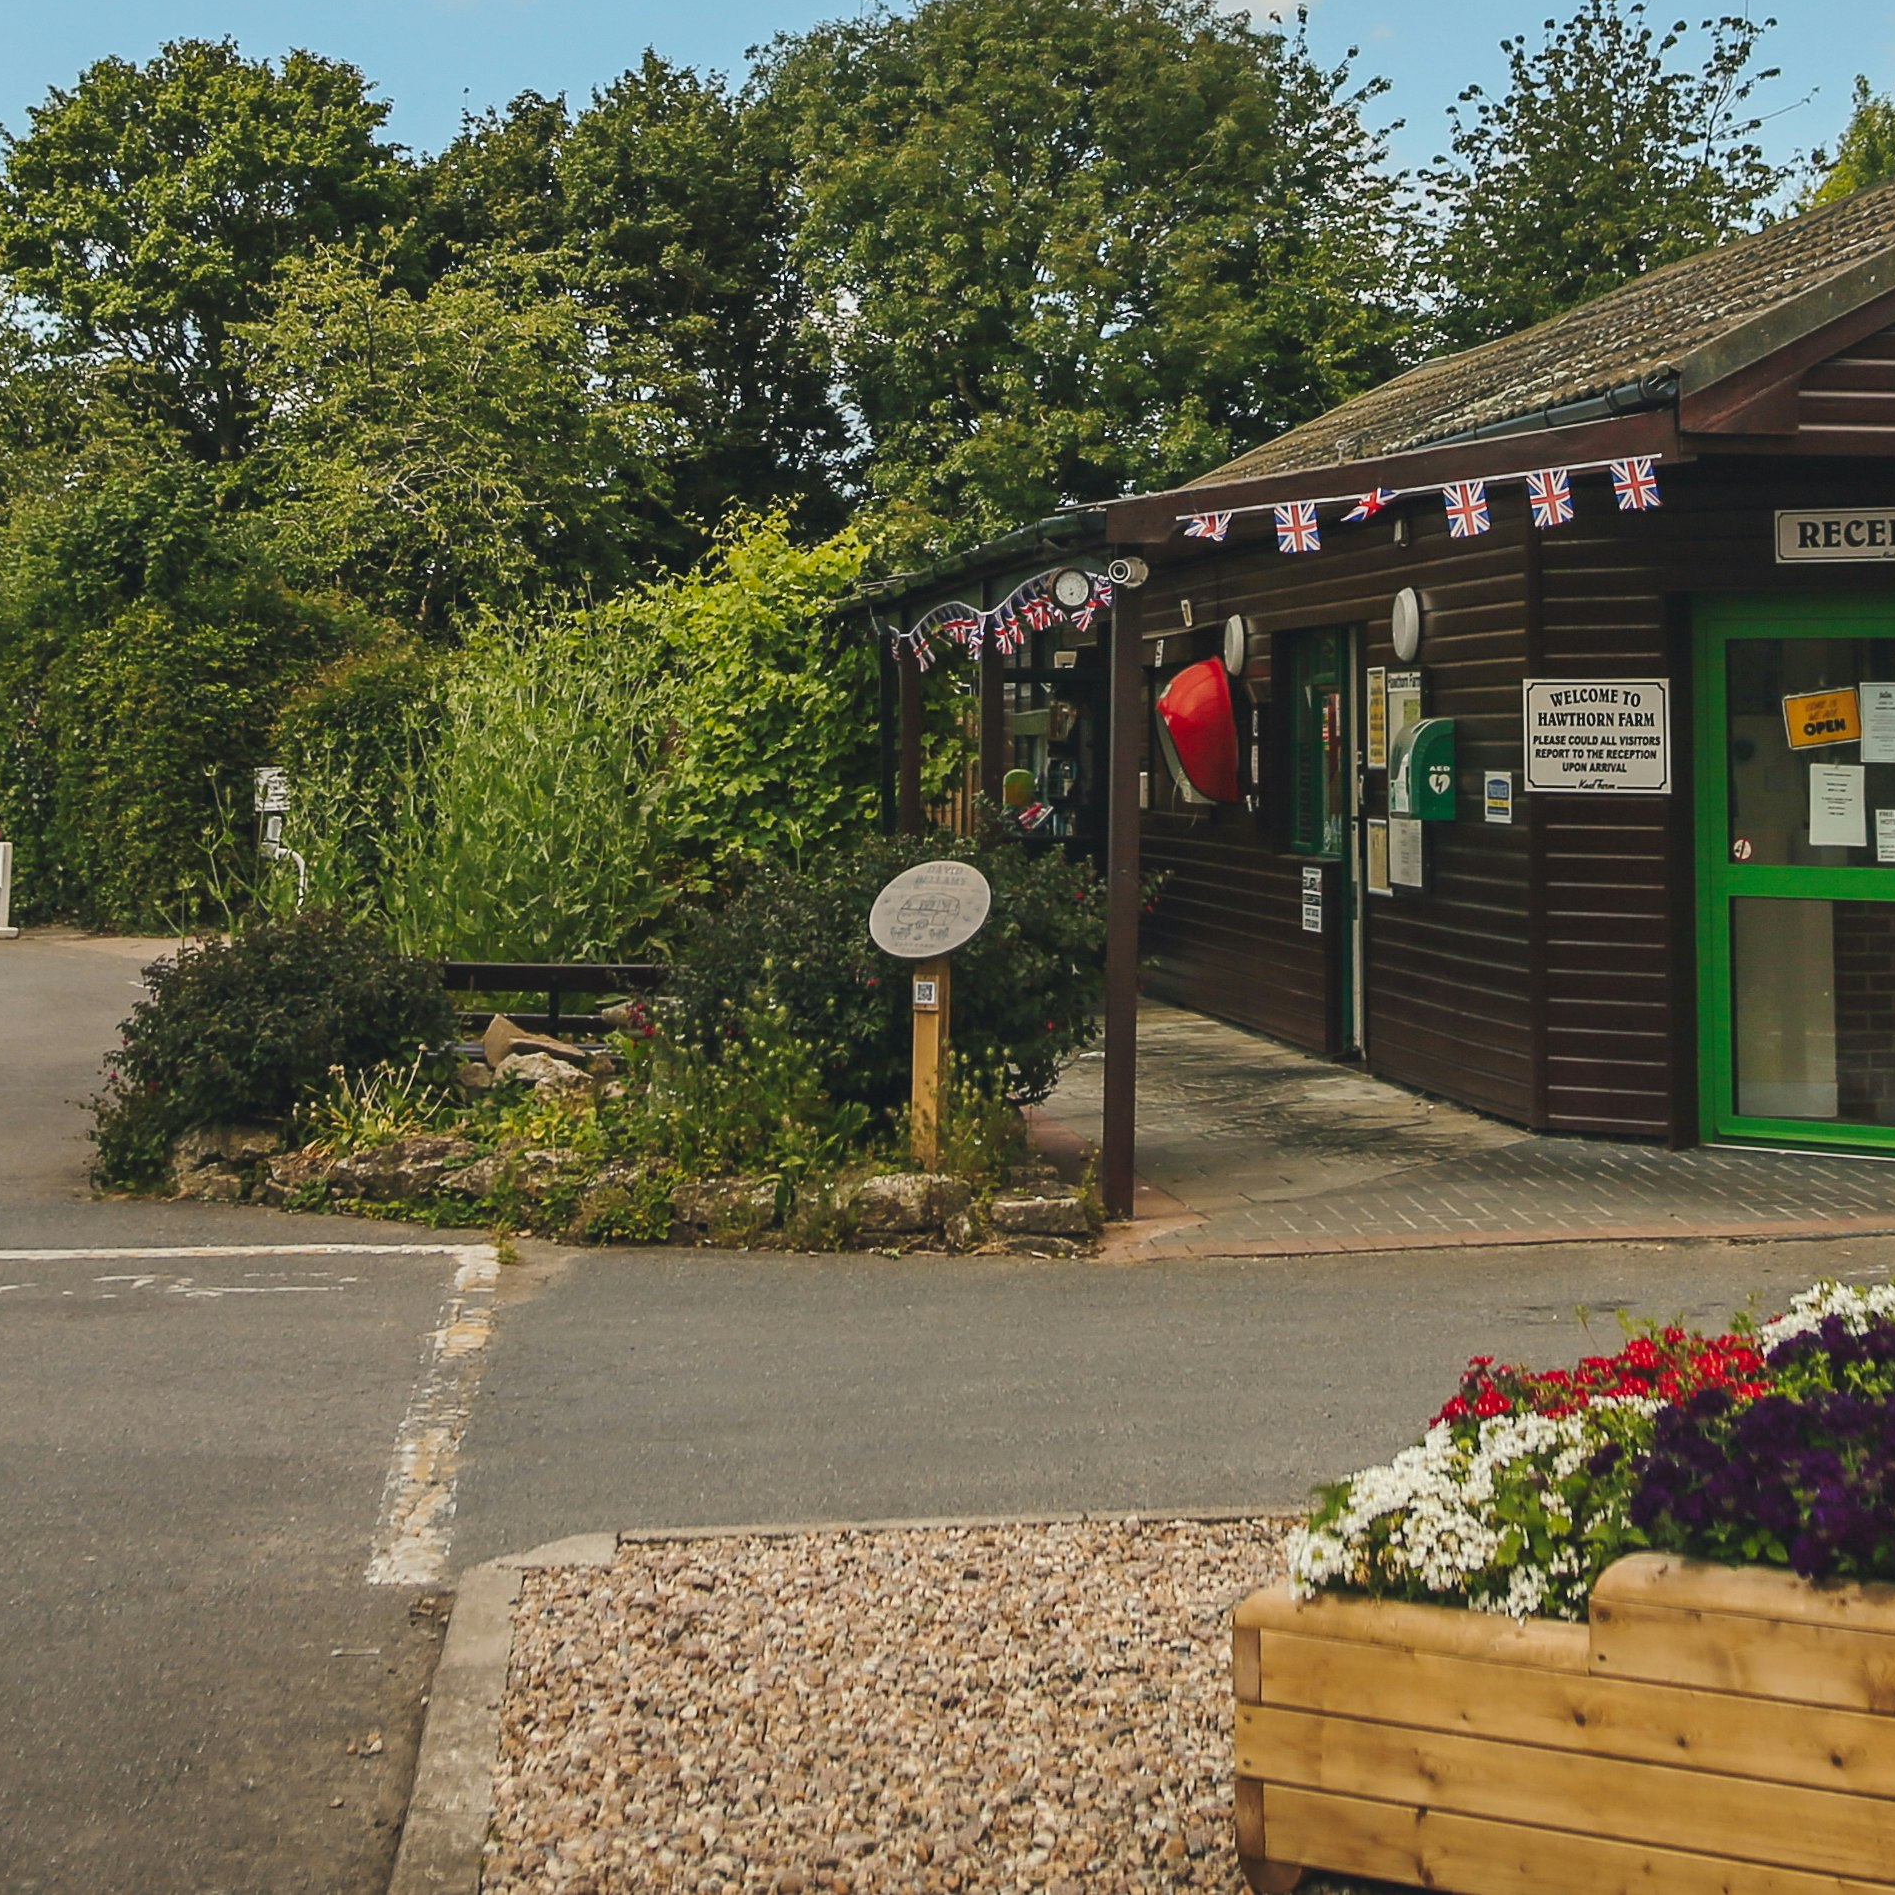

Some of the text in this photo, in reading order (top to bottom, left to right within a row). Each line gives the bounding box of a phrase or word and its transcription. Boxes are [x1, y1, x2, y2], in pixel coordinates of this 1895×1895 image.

[1550, 688, 1641, 707] WELCOME TO
[1538, 712, 1655, 727] HAWTHORN FARM
[1803, 718, 1846, 736] OPEN
[1533, 735, 1661, 746] PLEASE COULD ALL VISITORS
[1535, 749, 1657, 759] REPORT TO THE RECEPTION
[1562, 762, 1627, 773] UPON ARRIVAL
[927, 865, 964, 875] DAVID
[915, 875, 967, 886] BELLAMY
